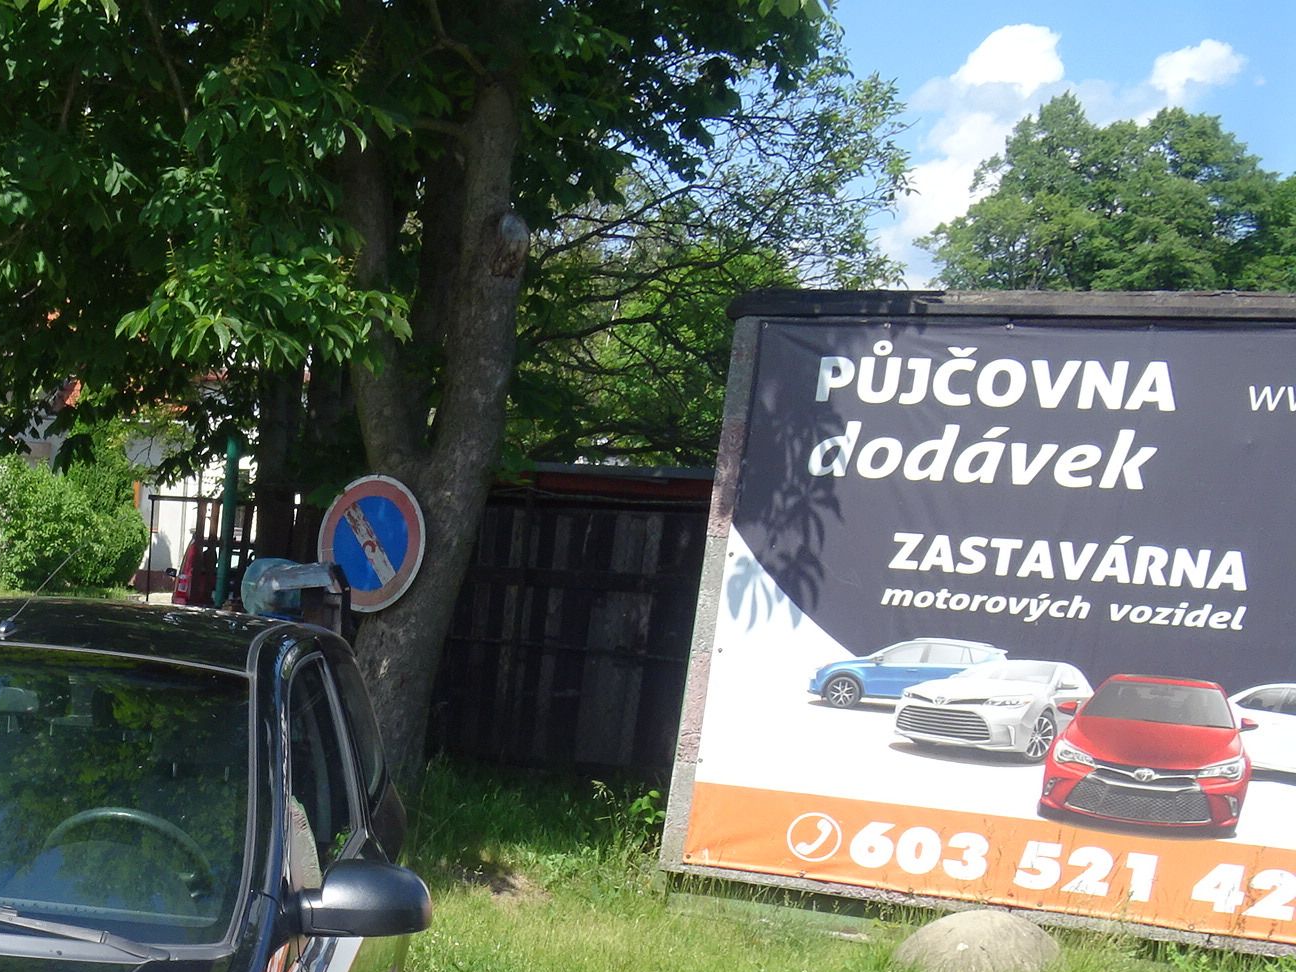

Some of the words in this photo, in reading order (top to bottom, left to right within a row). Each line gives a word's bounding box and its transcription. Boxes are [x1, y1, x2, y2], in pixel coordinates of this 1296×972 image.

[815, 340, 1176, 412] PŮJČOVNA
[1249, 385, 1296, 411] w
[808, 421, 1158, 490] dodávek
[888, 532, 1247, 591] ZASTAVÁRNA
[881, 585, 1091, 623] motorových
[1109, 601, 1246, 631] vozidel
[849, 822, 988, 881] 603
[1013, 840, 1159, 902] 521
[1191, 863, 1296, 921] 42
